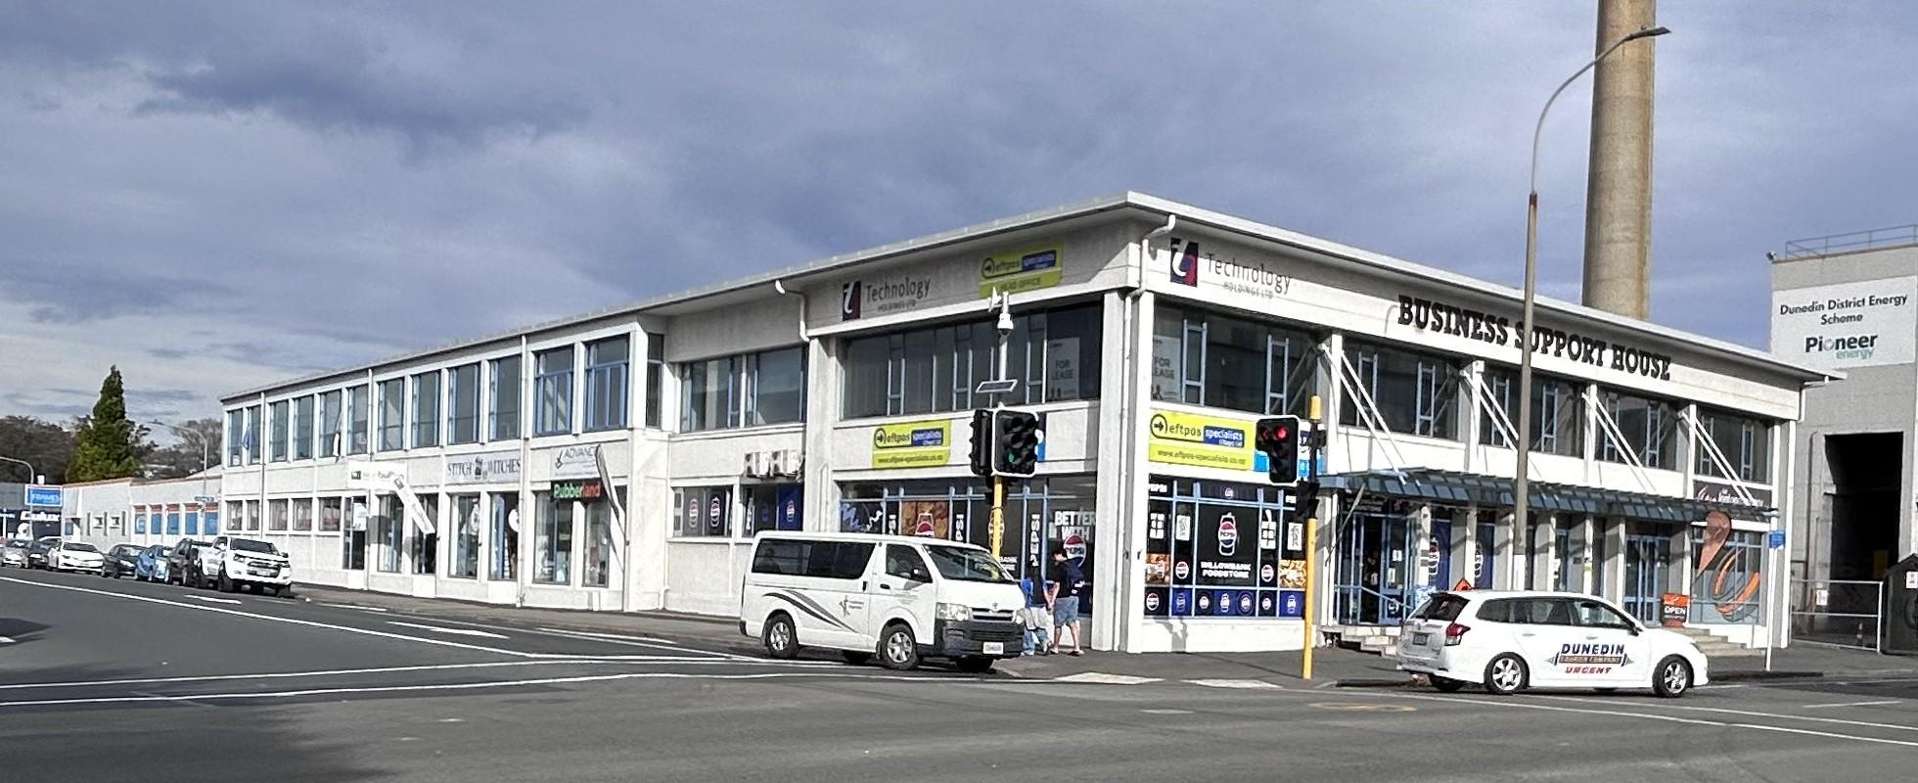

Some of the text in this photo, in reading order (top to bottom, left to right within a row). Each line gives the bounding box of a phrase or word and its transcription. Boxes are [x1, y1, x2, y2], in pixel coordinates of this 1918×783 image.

[1207, 252, 1290, 294] Technology
[866, 277, 931, 303] Technology
[1780, 294, 1907, 315] Dunedin District Energy
[1821, 313, 1863, 325] Scheme
[1398, 295, 1671, 380] BUSINESS SUPPORT HOUSE
[1805, 334, 1878, 352] Pioneer
[1836, 350, 1874, 360] energy
[887, 432, 910, 443] eftpos
[1169, 423, 1243, 441] eftpos specialists
[447, 459, 521, 476] STITCH WITCHES
[553, 482, 601, 498] Rubberland
[1055, 510, 1096, 526] BETTER
[1061, 526, 1089, 540] WITH
[1200, 561, 1251, 571] WILLOWBANK
[1202, 570, 1250, 578] FOODSTORE
[1664, 606, 1687, 615] OPEN
[1561, 643, 1625, 655] DUNEDIN
